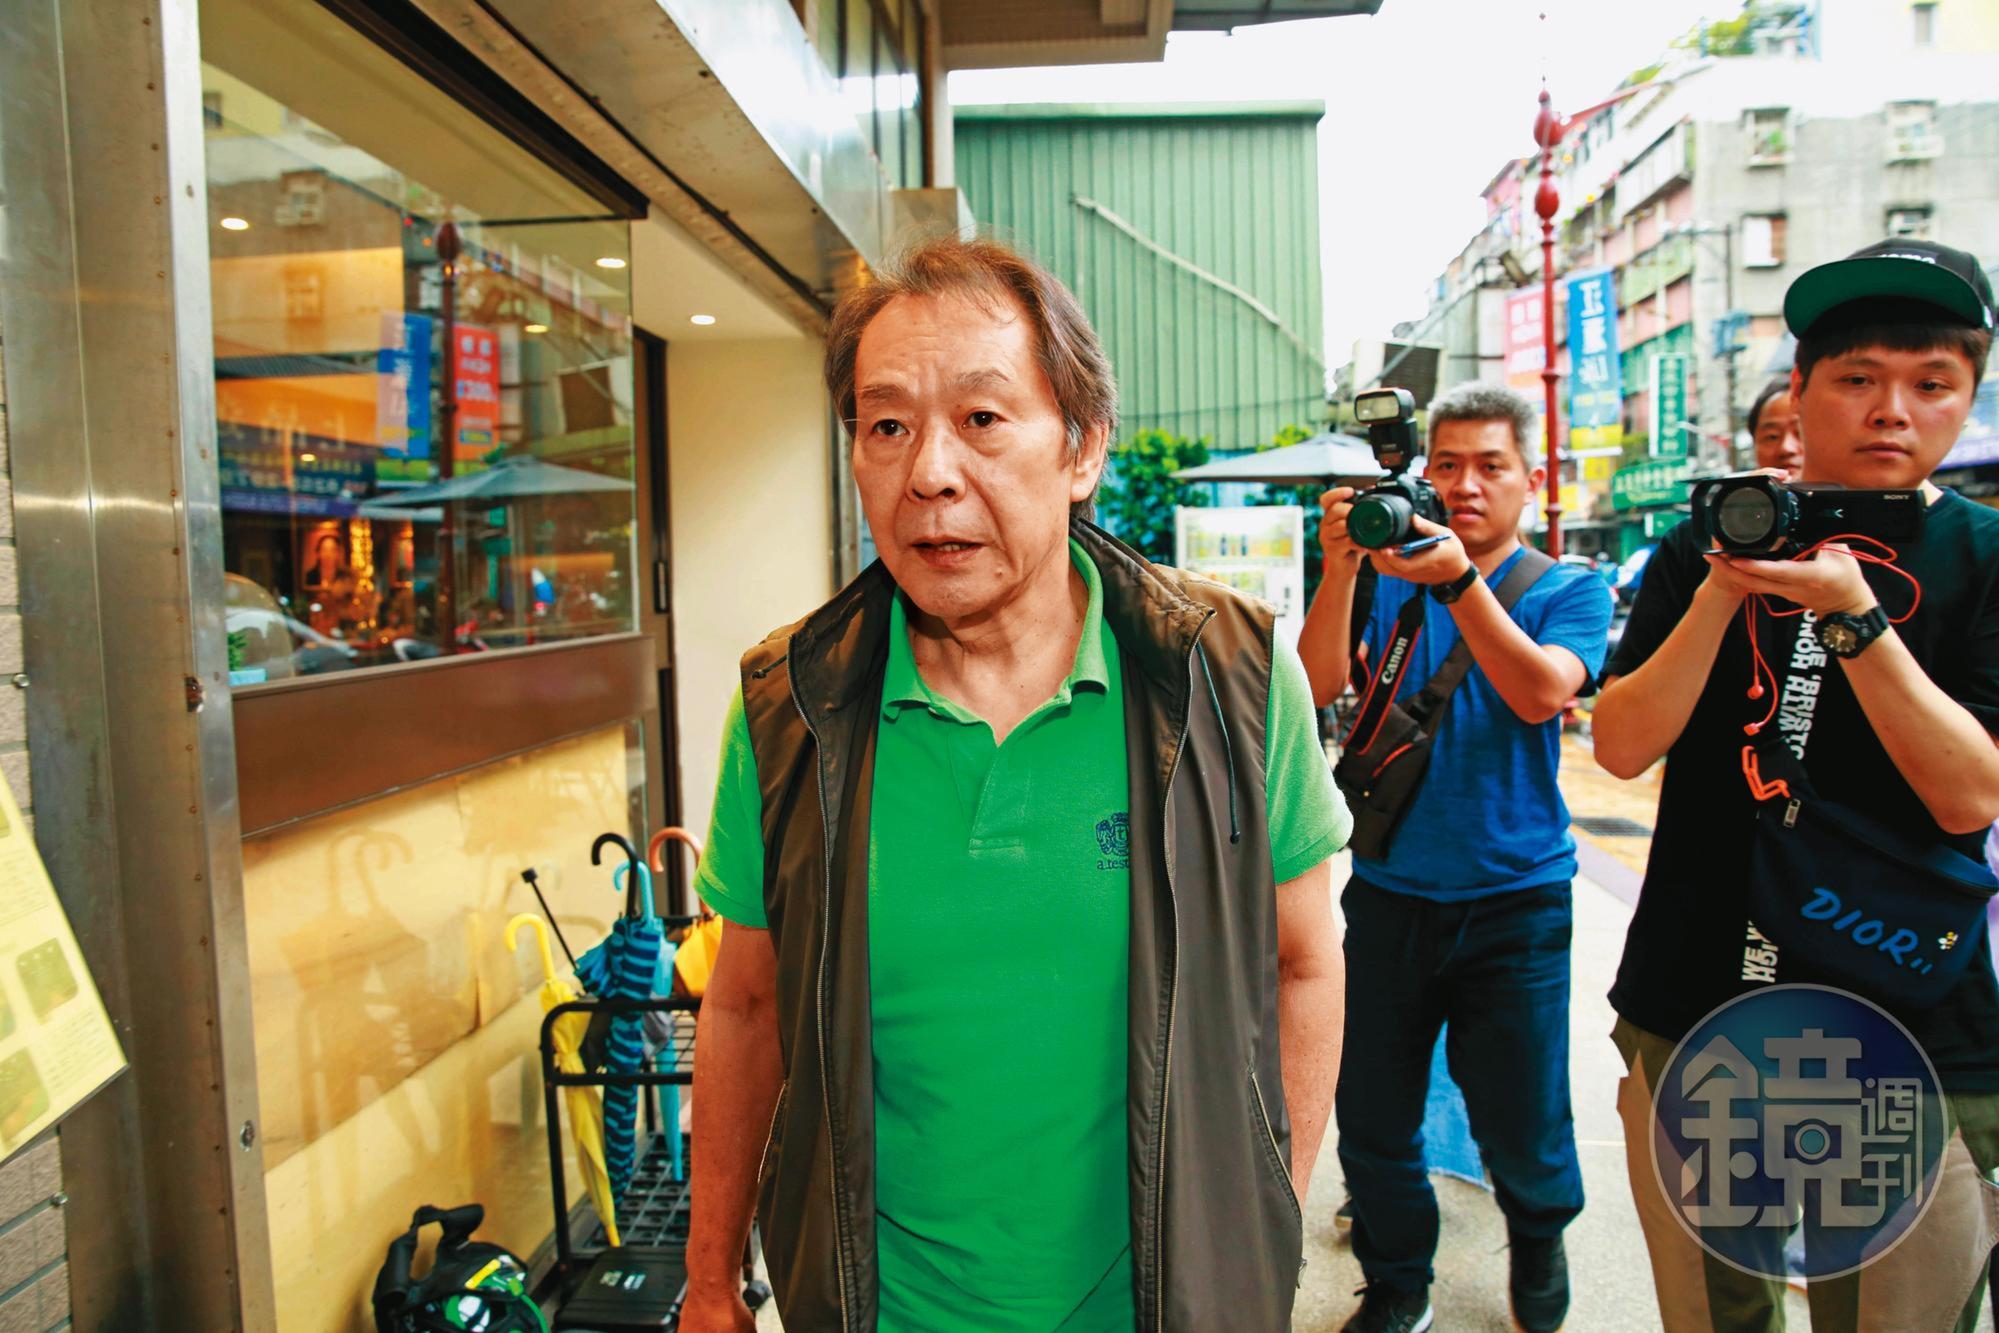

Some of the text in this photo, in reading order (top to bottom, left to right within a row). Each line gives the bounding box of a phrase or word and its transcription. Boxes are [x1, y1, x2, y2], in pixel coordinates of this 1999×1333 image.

[1381, 637, 1408, 684] Canon
[1790, 609, 1818, 669] HONO
[1801, 887, 1919, 965] DIOR
